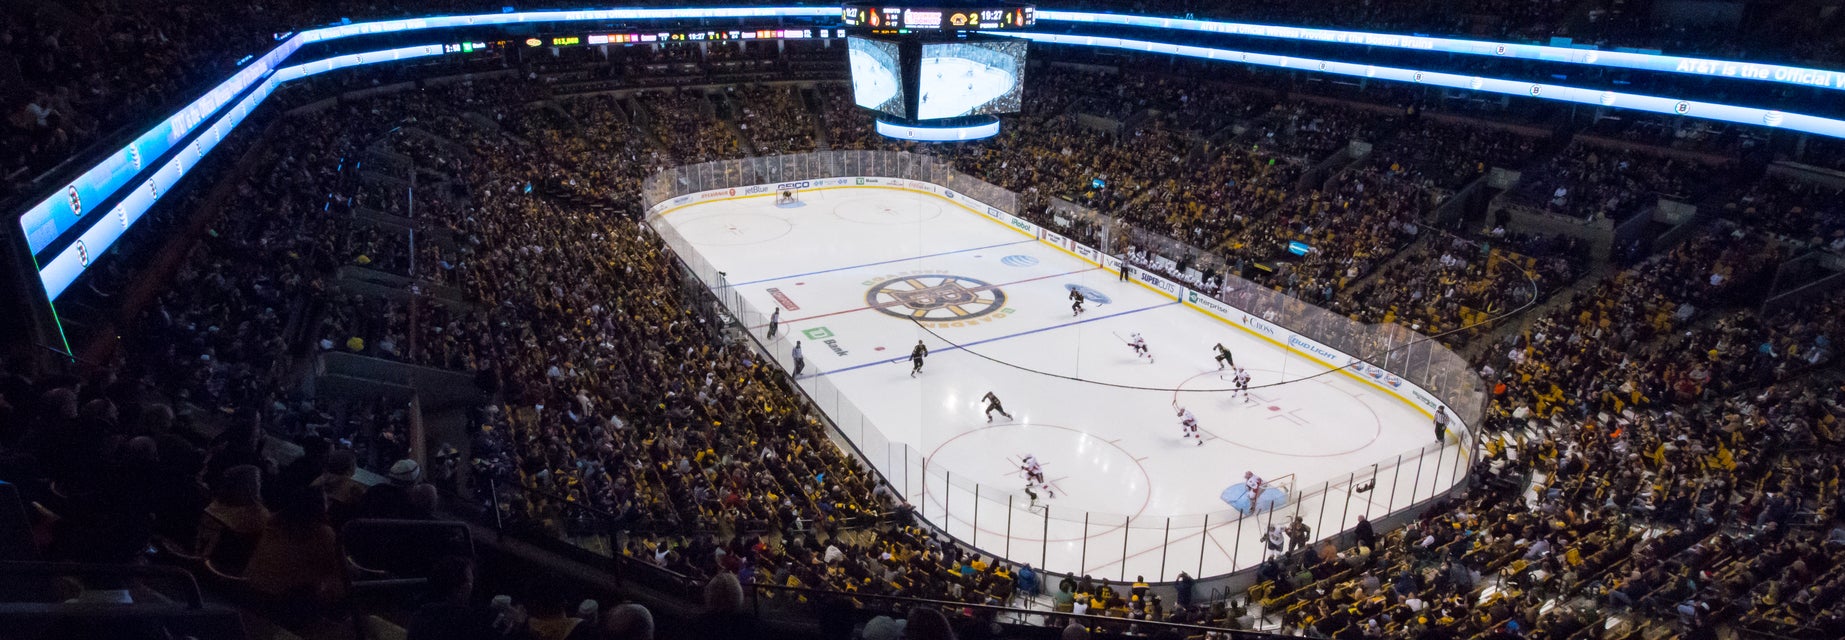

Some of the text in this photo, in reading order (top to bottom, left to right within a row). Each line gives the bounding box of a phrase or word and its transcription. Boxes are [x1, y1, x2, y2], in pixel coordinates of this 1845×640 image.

[860, 11, 865, 23] 1
[969, 13, 979, 25] 2
[981, 10, 1003, 21] 19:27
[1006, 12, 1012, 24] 1
[1200, 21, 1433, 49] AT&T is the Official Wireless Provider of the Boston Bruins
[1677, 57, 1720, 74] AT&T
[1722, 60, 1737, 77] is
[1741, 64, 1770, 80] the
[1774, 67, 1831, 87] Official
[745, 185, 768, 196] jetBlue
[777, 181, 810, 189] GEICO
[1011, 217, 1031, 231] iRobot
[1141, 272, 1175, 293] SUPERCUTS
[1249, 317, 1274, 335] CROSS
[823, 339, 849, 357] Bank
[1290, 336, 1336, 360] BUD LIGHT
